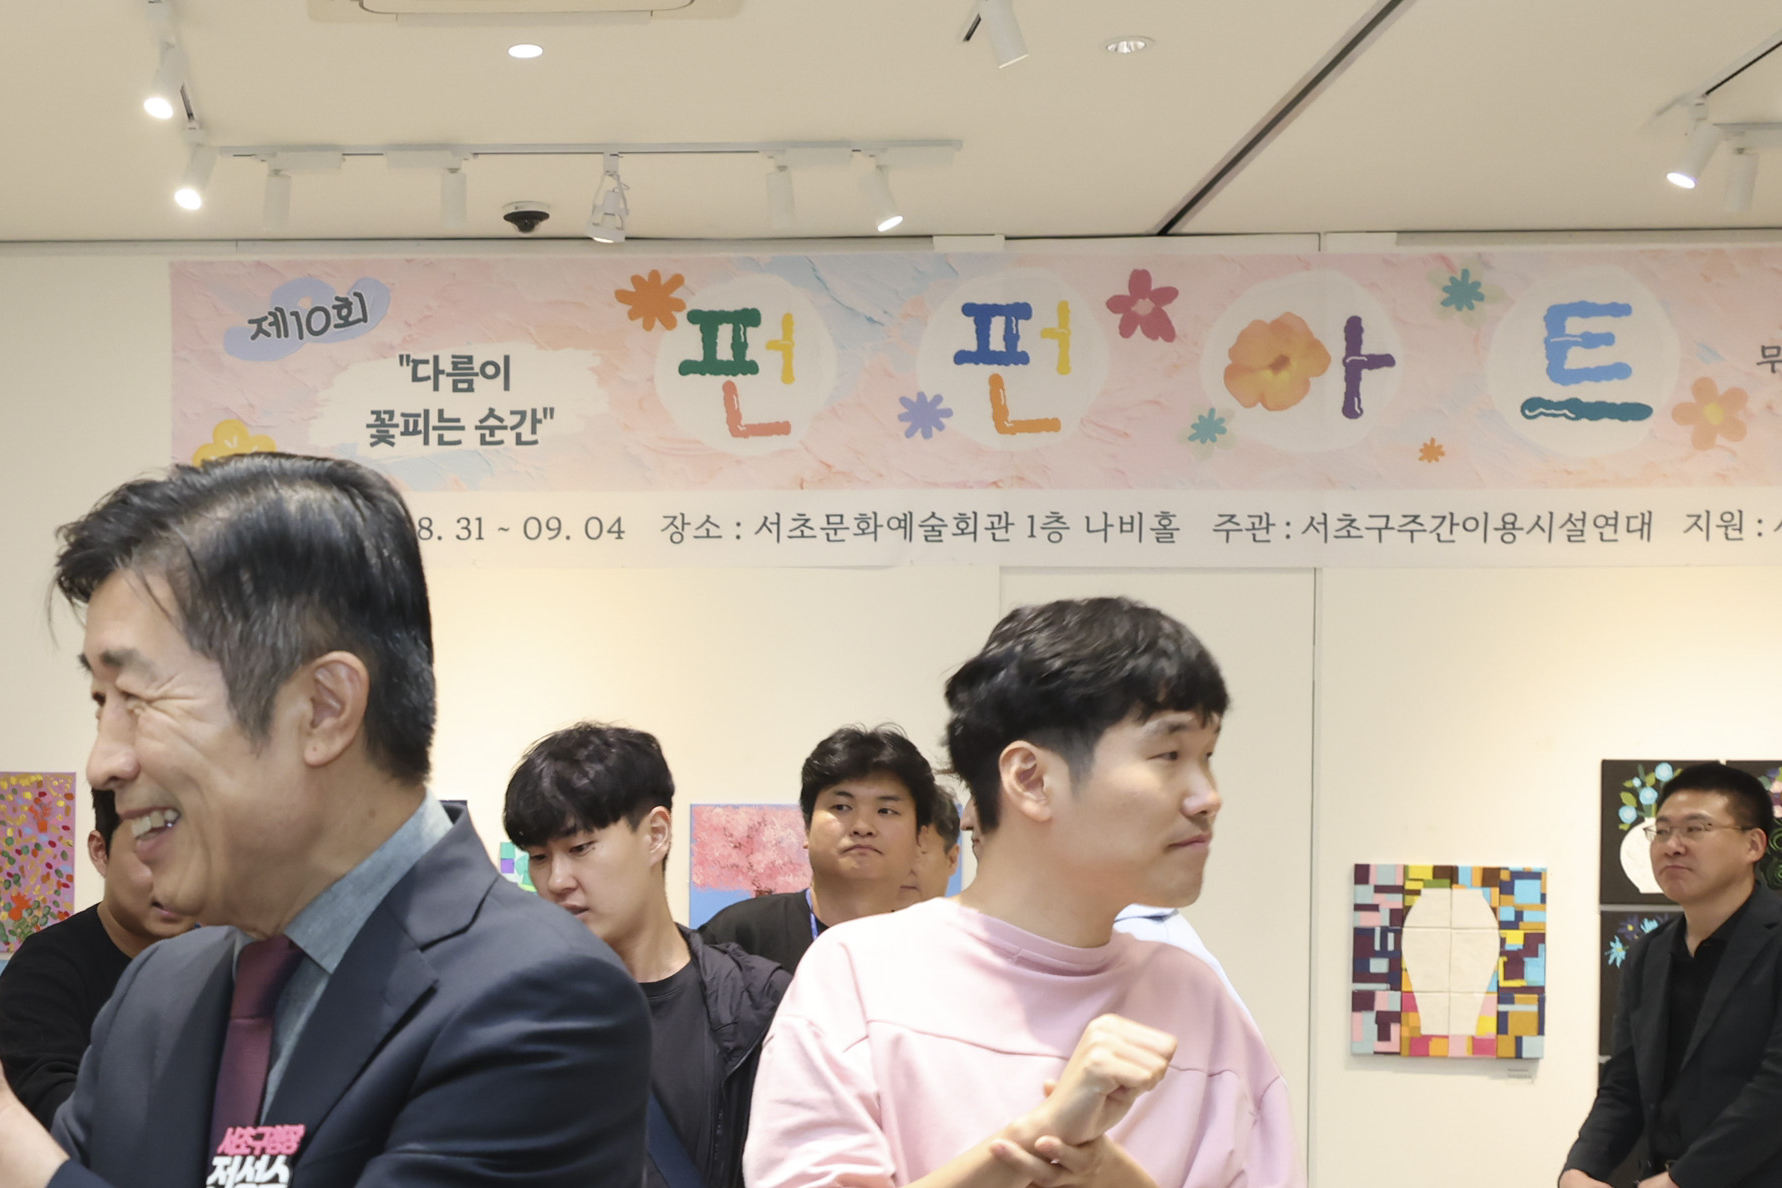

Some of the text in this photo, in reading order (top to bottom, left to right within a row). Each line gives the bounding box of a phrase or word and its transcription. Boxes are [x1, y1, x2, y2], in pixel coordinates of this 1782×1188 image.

[247, 291, 369, 341] 제10회
[398, 353, 511, 394] "다름이
[365, 406, 555, 448] 꽃피는 순간"
[455, 516, 485, 542] 31
[522, 516, 571, 541] 09.
[584, 516, 626, 541] 04
[753, 510, 1016, 545] 서초문화예술회관
[1026, 510, 1071, 544] 1층
[1084, 510, 1181, 544] 나비홀
[1300, 509, 1653, 545] 서초구주간이용시설연대
[217, 1124, 306, 1156] 서초구청장
